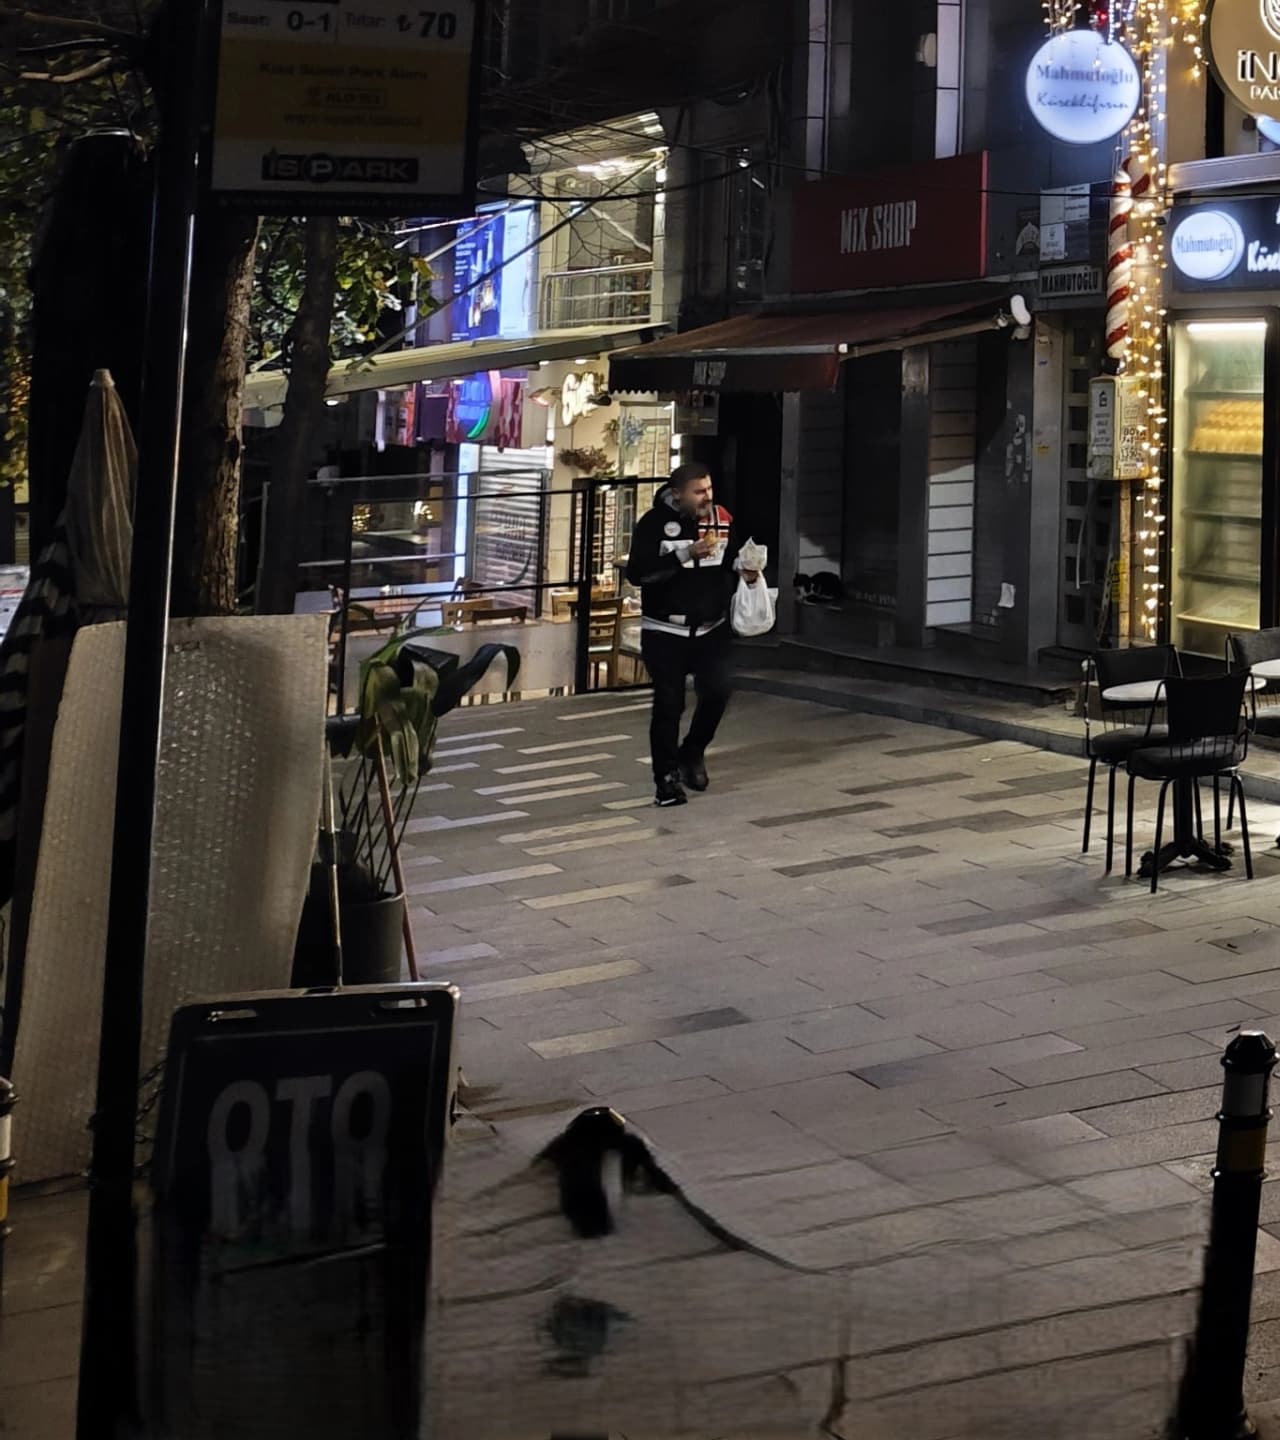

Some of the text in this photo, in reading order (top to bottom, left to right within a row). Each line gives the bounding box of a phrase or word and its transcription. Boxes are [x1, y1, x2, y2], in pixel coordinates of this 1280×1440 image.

[418, 11, 456, 40] 70
[872, 200, 917, 250] SHOP
[1041, 267, 1099, 292] MAHMUTOĞLU
